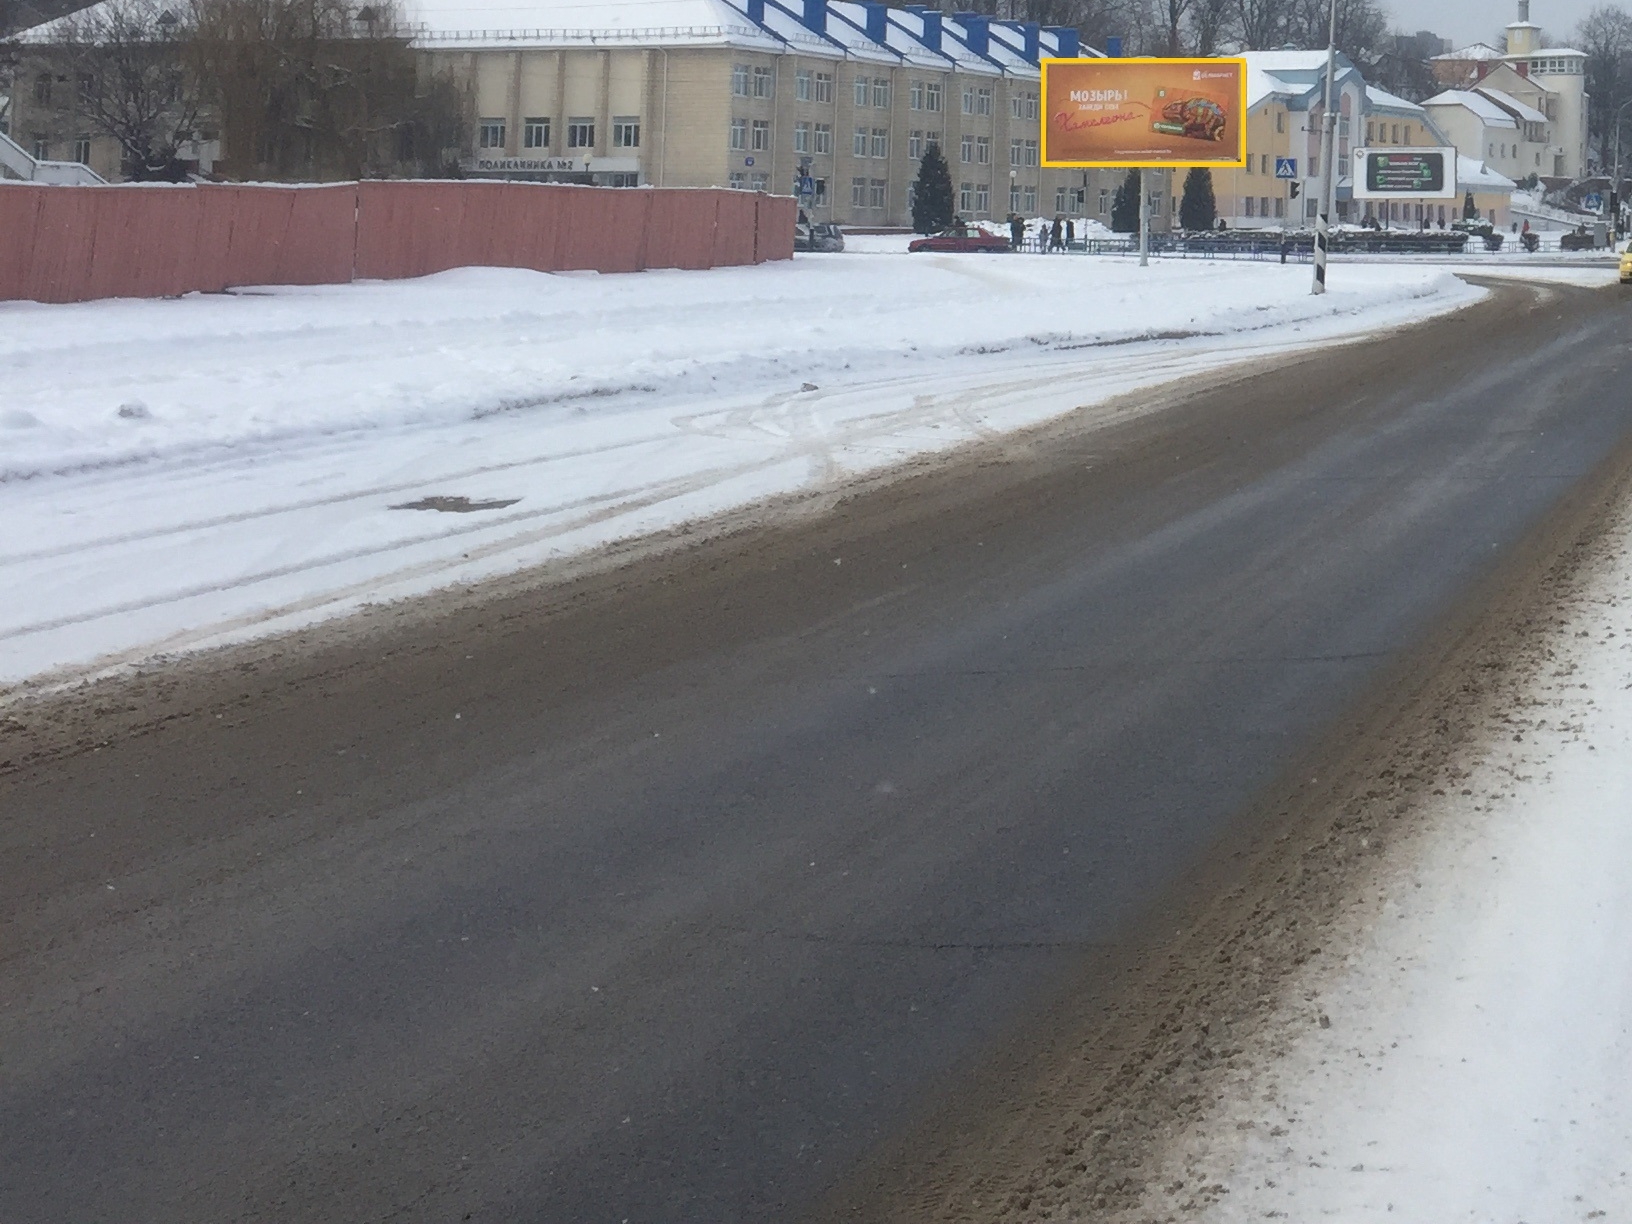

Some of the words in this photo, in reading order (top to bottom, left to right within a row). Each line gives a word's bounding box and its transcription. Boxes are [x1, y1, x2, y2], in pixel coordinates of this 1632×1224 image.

[1070, 90, 1128, 102] МОЗЫРЬ!
[479, 160, 554, 171] ПОЛИКЛИНИКА
[556, 160, 574, 170] №2
